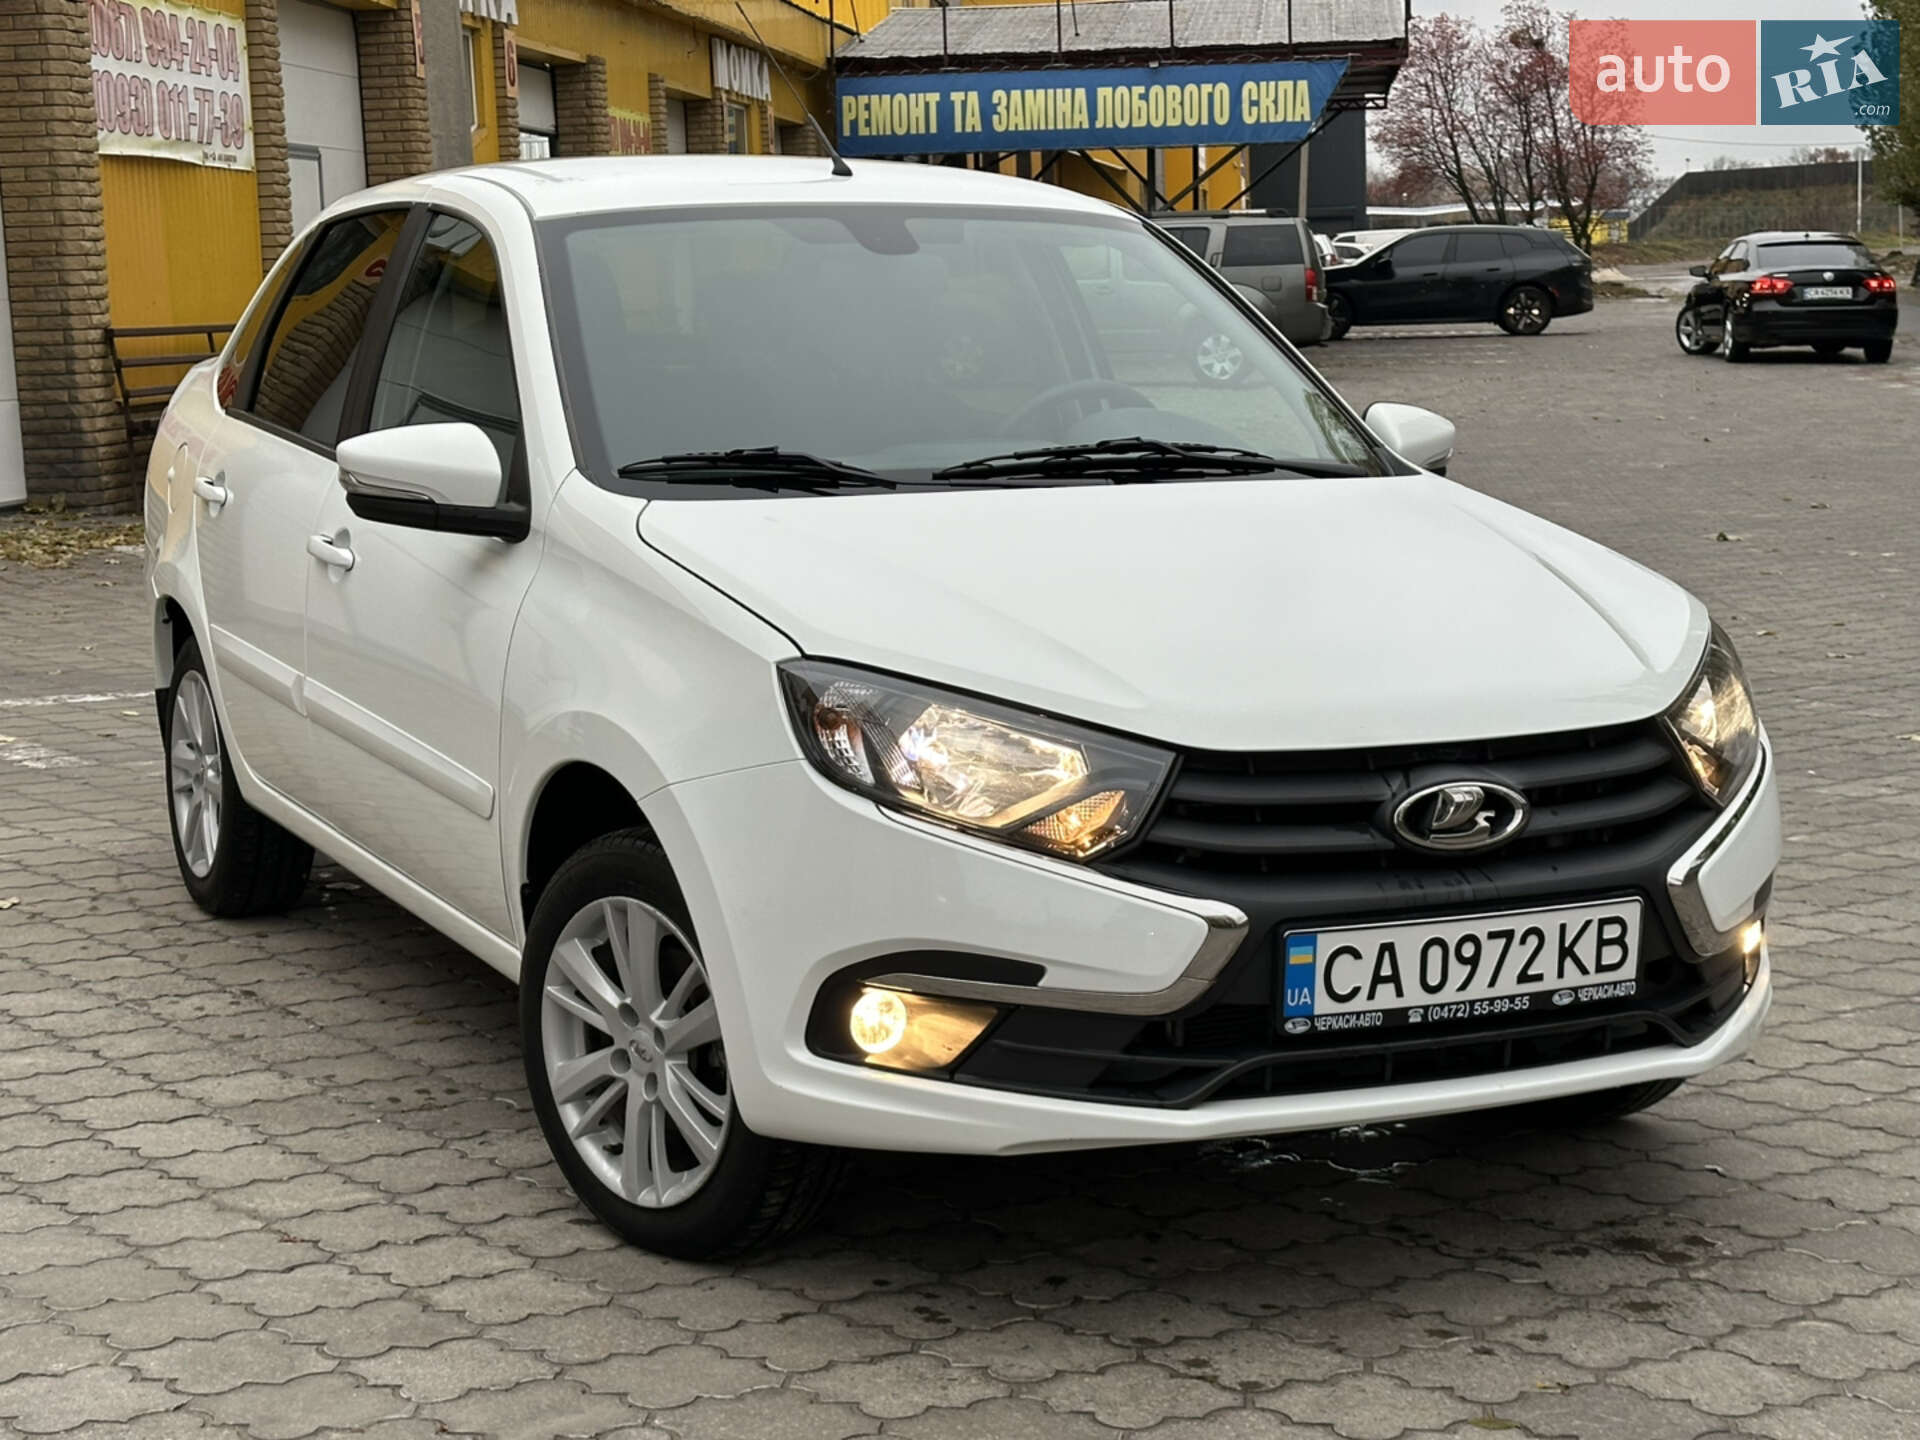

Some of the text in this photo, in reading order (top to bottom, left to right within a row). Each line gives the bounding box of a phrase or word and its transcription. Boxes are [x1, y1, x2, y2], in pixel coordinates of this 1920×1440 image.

[141, 6, 240, 82] 994-24-04
[507, 40, 516, 87] 6
[156, 79, 245, 150] 011-77-39
[841, 79, 1312, 137] РЕМОНТ ТА ЗАМІНА ЛОБОВОГО СКЛА
[1323, 914, 1630, 1003] CA 0972 KB
[1287, 987, 1312, 1007] UA
[1427, 996, 1531, 1022] (0472) 55-99-55
[1577, 981, 1637, 1001] ЧЕРКАСИ-АВТО
[1314, 1012, 1384, 1031] ЧЕРКАСИ-АВТО
